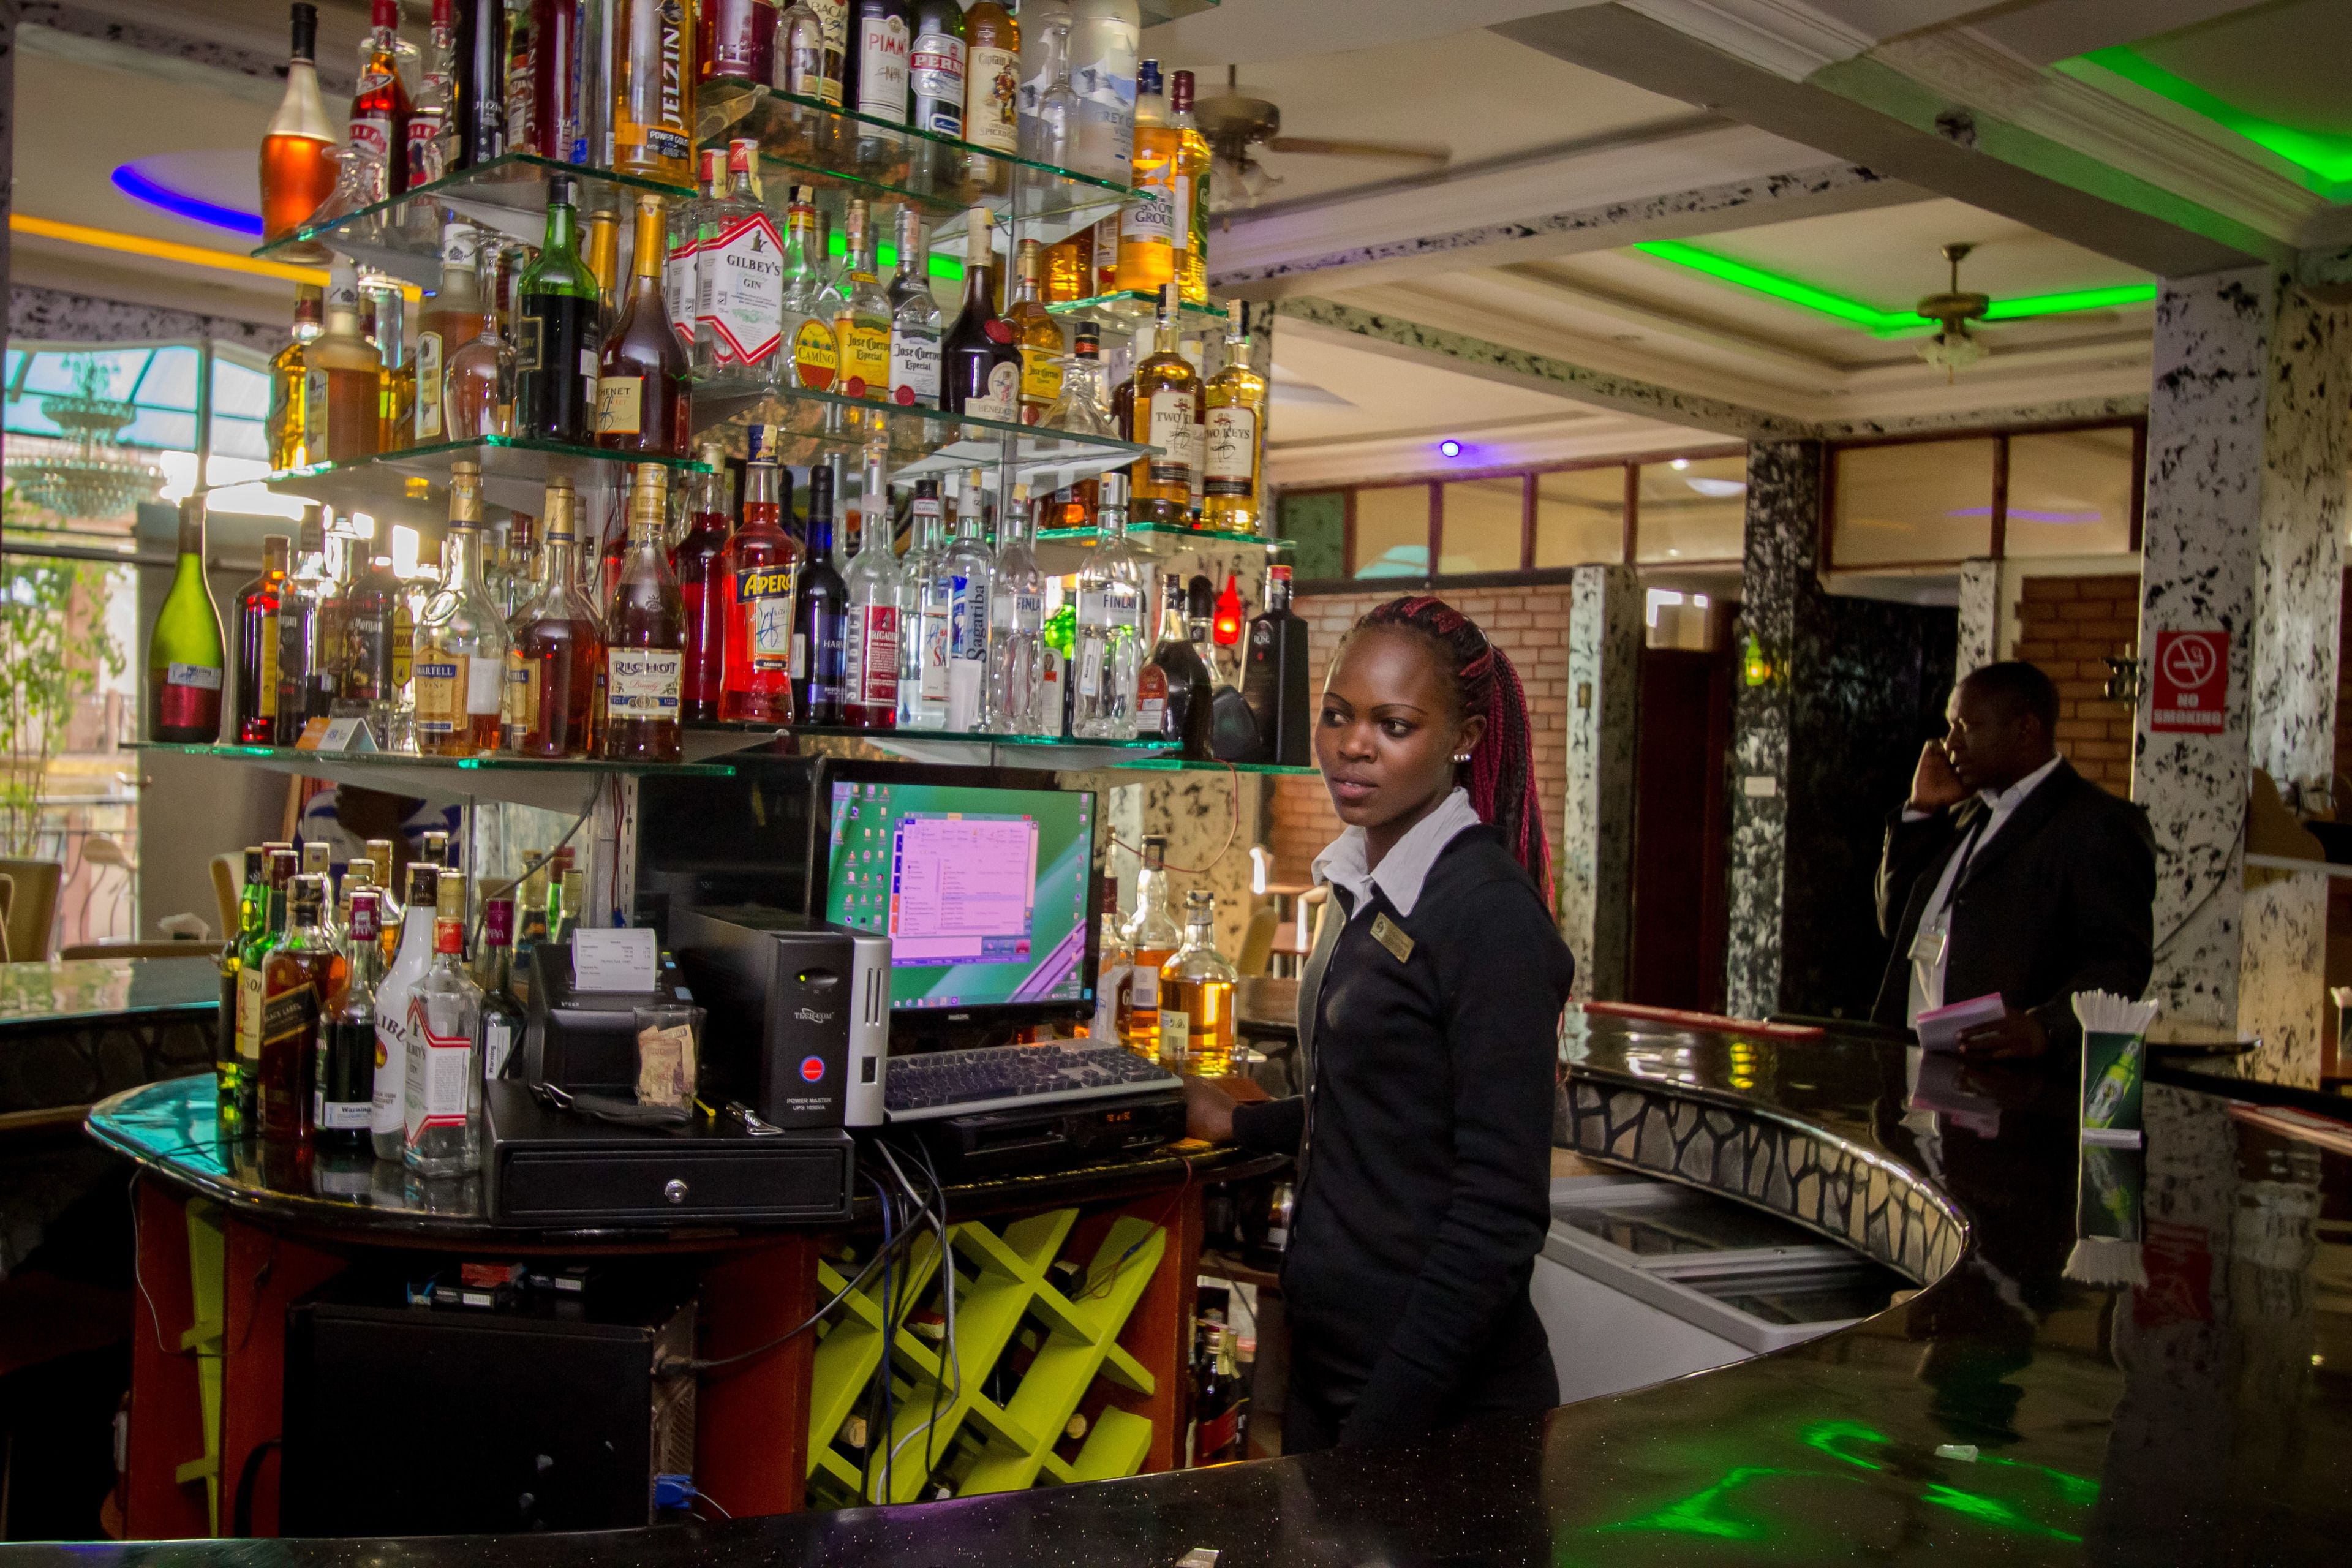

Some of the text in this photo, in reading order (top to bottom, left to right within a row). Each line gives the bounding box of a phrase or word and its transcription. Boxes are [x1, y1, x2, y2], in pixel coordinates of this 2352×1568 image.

[978, 52, 1006, 67] Captain
[662, 27, 683, 130] JELZIN
[727, 254, 780, 276] GILBEY'S
[744, 278, 762, 290] GIN
[847, 333, 865, 347] Jose
[856, 349, 876, 361] Especial
[894, 344, 913, 357] Jose
[905, 359, 930, 371] Especial
[1156, 412, 1181, 422] TWO
[355, 617, 383, 632] Morgan
[614, 661, 677, 676] RICHOT
